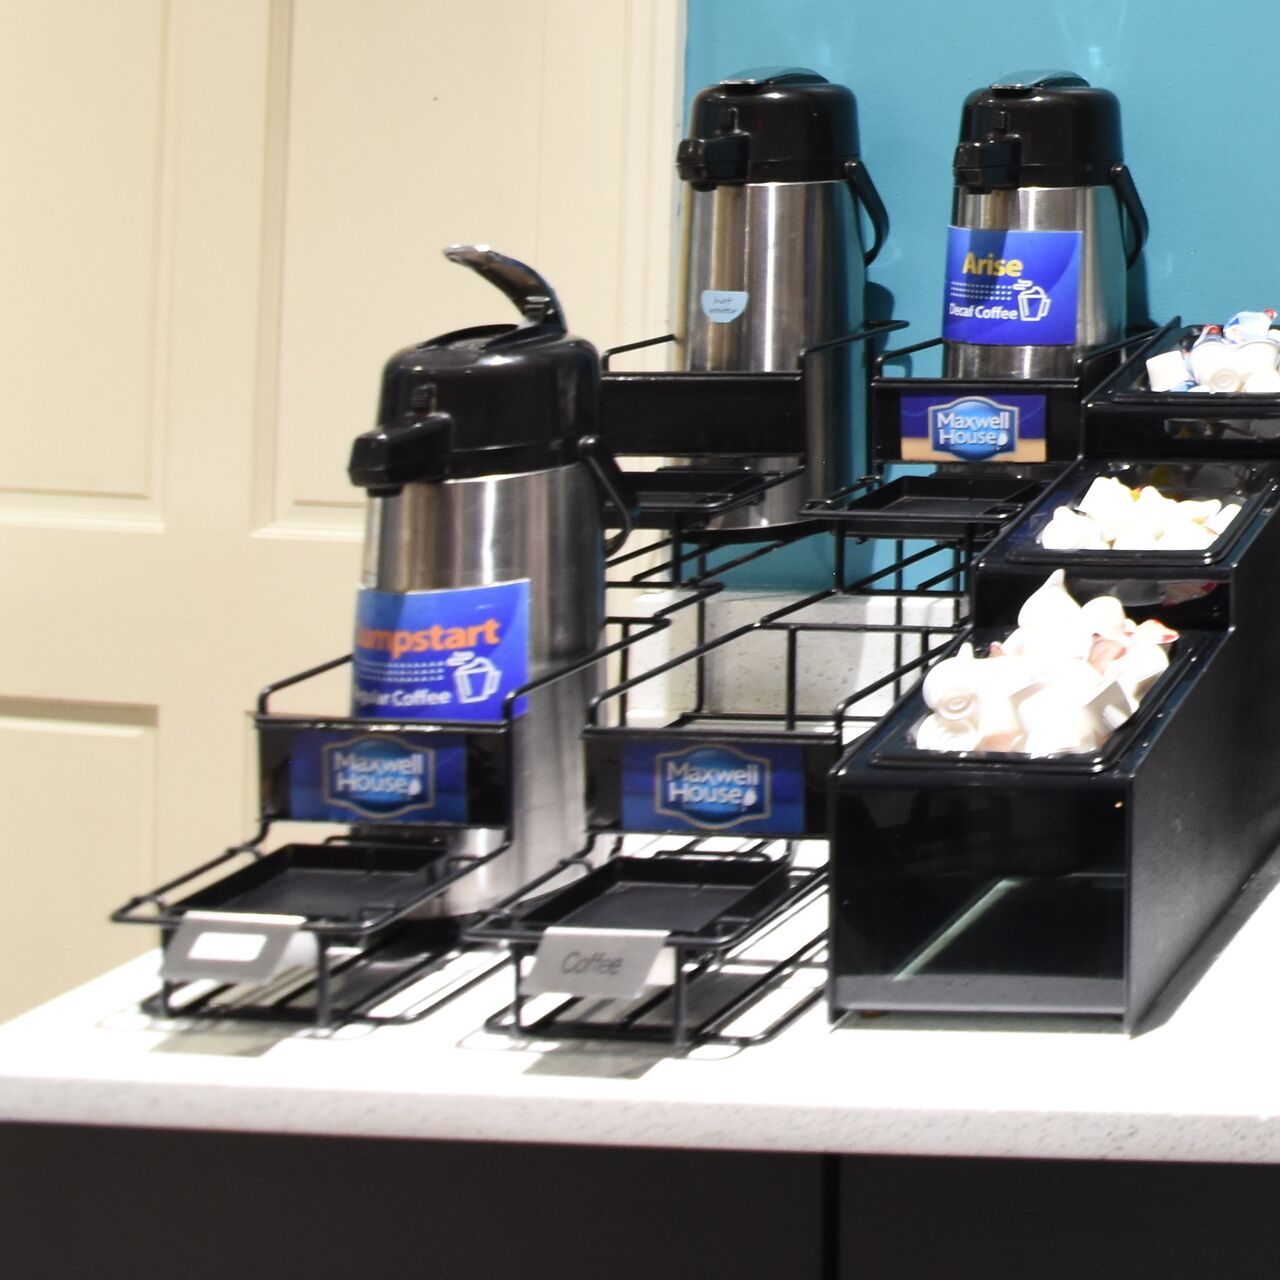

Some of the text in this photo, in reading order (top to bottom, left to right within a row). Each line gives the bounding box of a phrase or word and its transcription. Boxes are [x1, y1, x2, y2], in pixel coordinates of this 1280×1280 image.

[962, 252, 1024, 277] Arise
[949, 302, 1019, 320] Decaf Coffee
[936, 410, 1010, 431] Maxwell
[938, 428, 998, 446] House
[391, 688, 453, 707] Coffee
[333, 750, 424, 776] Maxwell
[667, 760, 760, 786] Maxwell
[334, 771, 411, 795] House
[668, 781, 744, 805] House
[561, 950, 624, 976] Coffee
